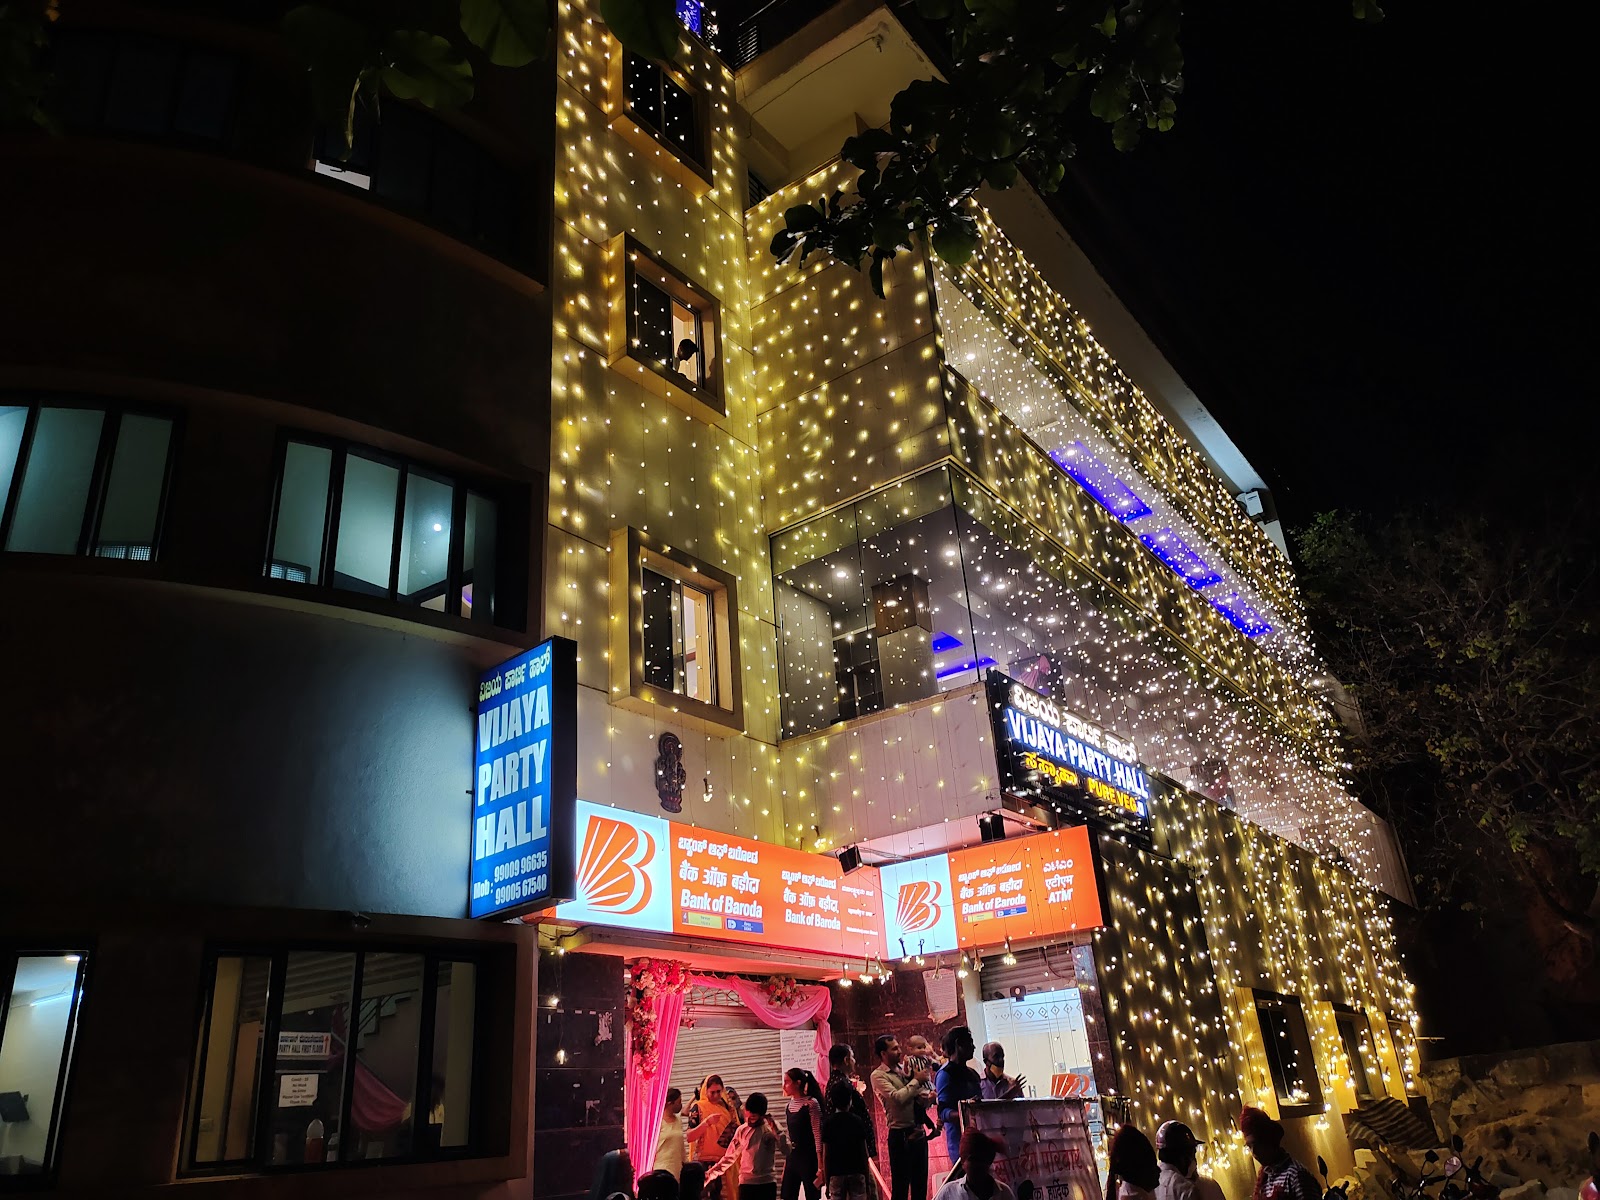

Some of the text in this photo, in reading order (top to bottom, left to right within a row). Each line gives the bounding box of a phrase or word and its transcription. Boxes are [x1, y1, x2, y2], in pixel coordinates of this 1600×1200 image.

[529, 646, 550, 679] ಹಾಲ್
[479, 685, 550, 752] VIJAYA
[1007, 708, 1067, 761] VIJAYA
[1067, 739, 1113, 782] PARTY
[1114, 761, 1150, 799] HALL
[1105, 731, 1137, 764] ಹಾಲ್
[477, 739, 547, 807] PARTY
[1087, 777, 1117, 803] PURE
[1116, 791, 1137, 813] VEG
[475, 795, 547, 861] HALL
[494, 850, 547, 883] 99009 96635
[679, 859, 700, 882] बैंक
[731, 870, 761, 895] बड़ौदा
[1045, 873, 1074, 891] एटीएम
[495, 873, 547, 905] 99005 67540
[680, 888, 763, 919] Bank of Baroda
[783, 887, 797, 906] बैंक
[960, 884, 974, 900] बैंक
[962, 899, 984, 915] Bank
[984, 898, 995, 911] of
[994, 893, 1026, 910] Baroda
[1048, 888, 1074, 904] ATM
[785, 909, 805, 926] Bank
[805, 914, 815, 927] of
[814, 913, 841, 931] Baroda
